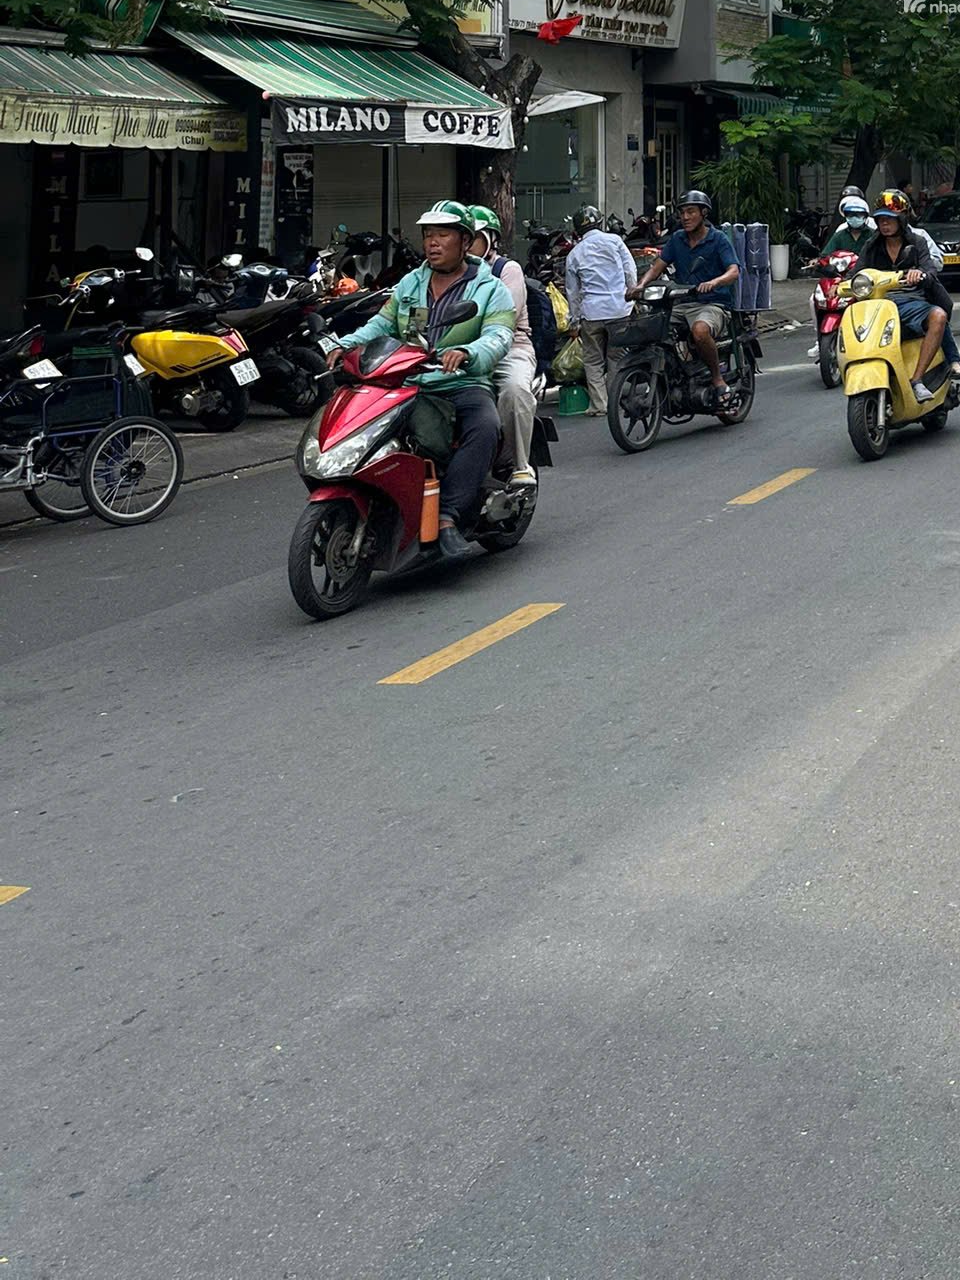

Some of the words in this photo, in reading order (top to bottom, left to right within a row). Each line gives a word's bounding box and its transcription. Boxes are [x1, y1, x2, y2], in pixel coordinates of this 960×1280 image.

[285, 106, 391, 133] MILANO
[423, 110, 501, 137] COFFE
[181, 135, 205, 146] (Chu)
